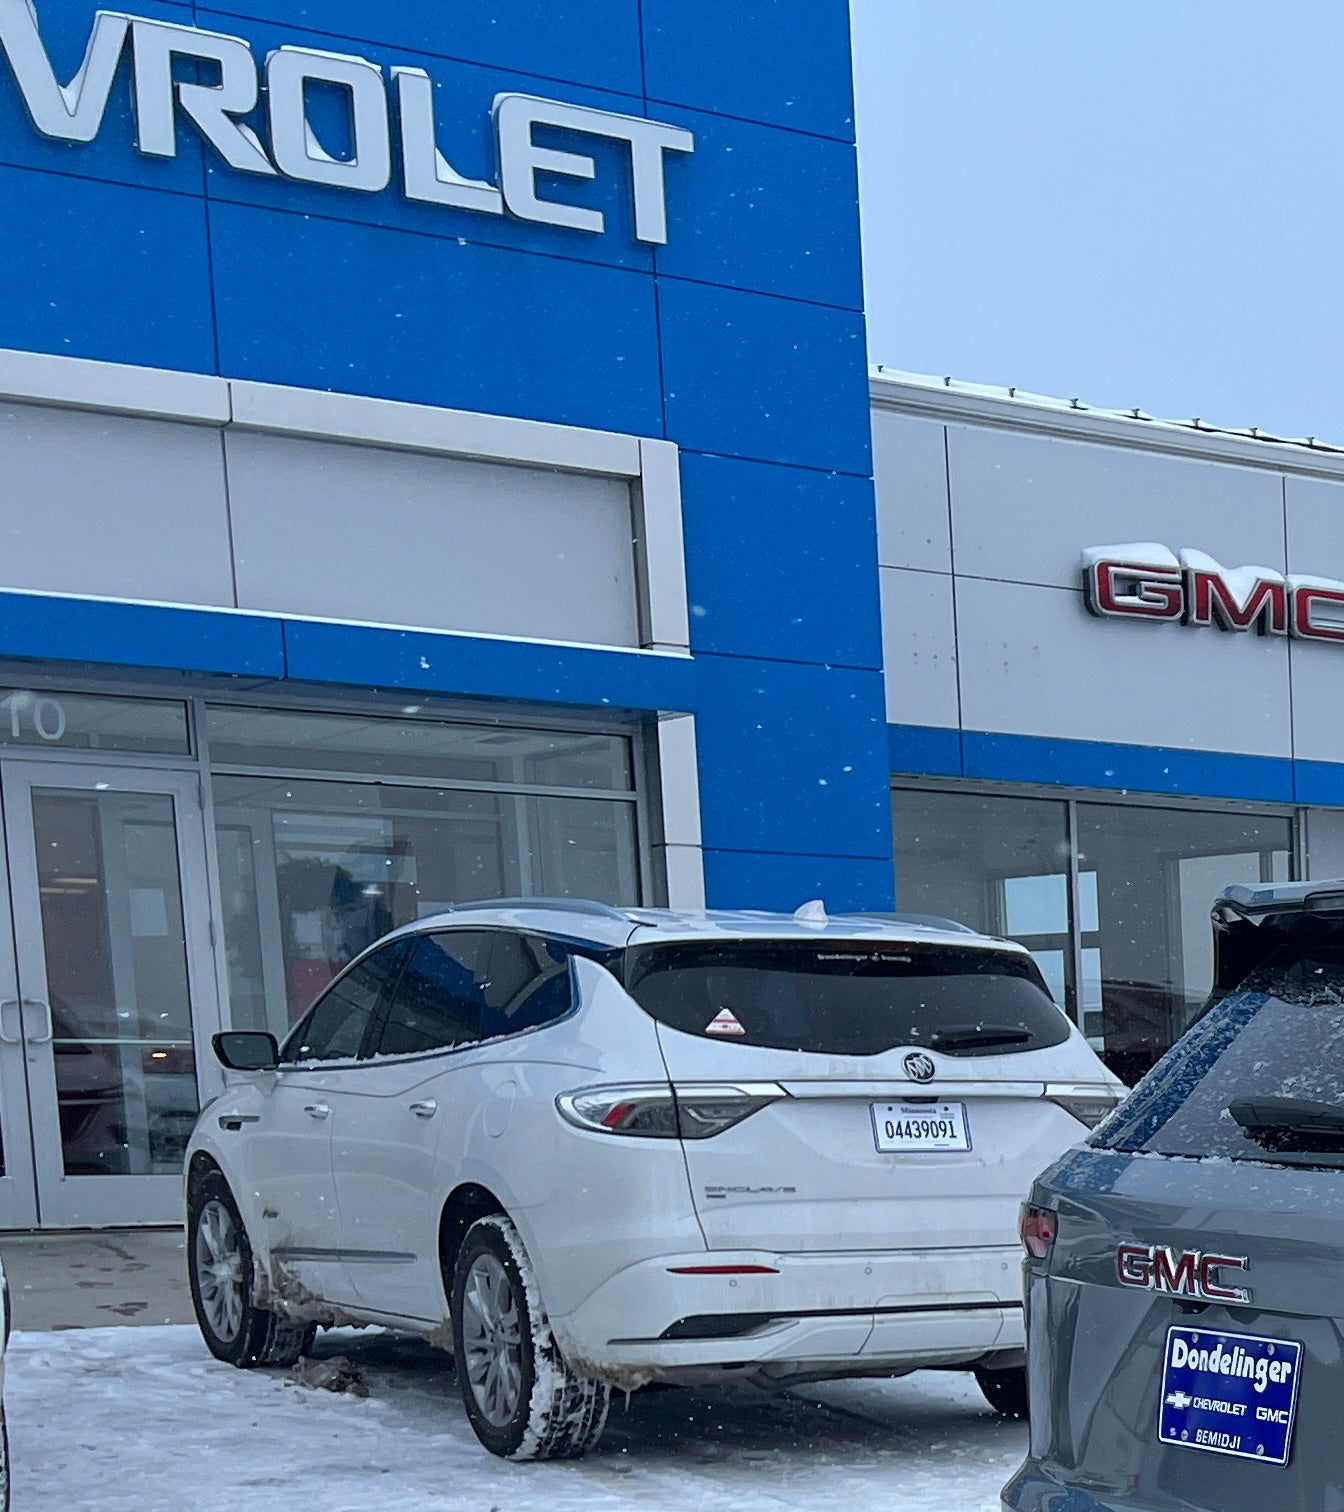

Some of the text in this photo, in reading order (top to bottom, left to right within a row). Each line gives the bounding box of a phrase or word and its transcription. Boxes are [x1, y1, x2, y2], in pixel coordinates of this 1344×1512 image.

[885, 1120, 957, 1139] 04439091
[1117, 1241, 1251, 1303] GMC
[1171, 1338, 1292, 1393] Dondelinger
[1193, 1396, 1288, 1424] CHEVROLET GMC
[1195, 1429, 1241, 1449] BEMIDJI
